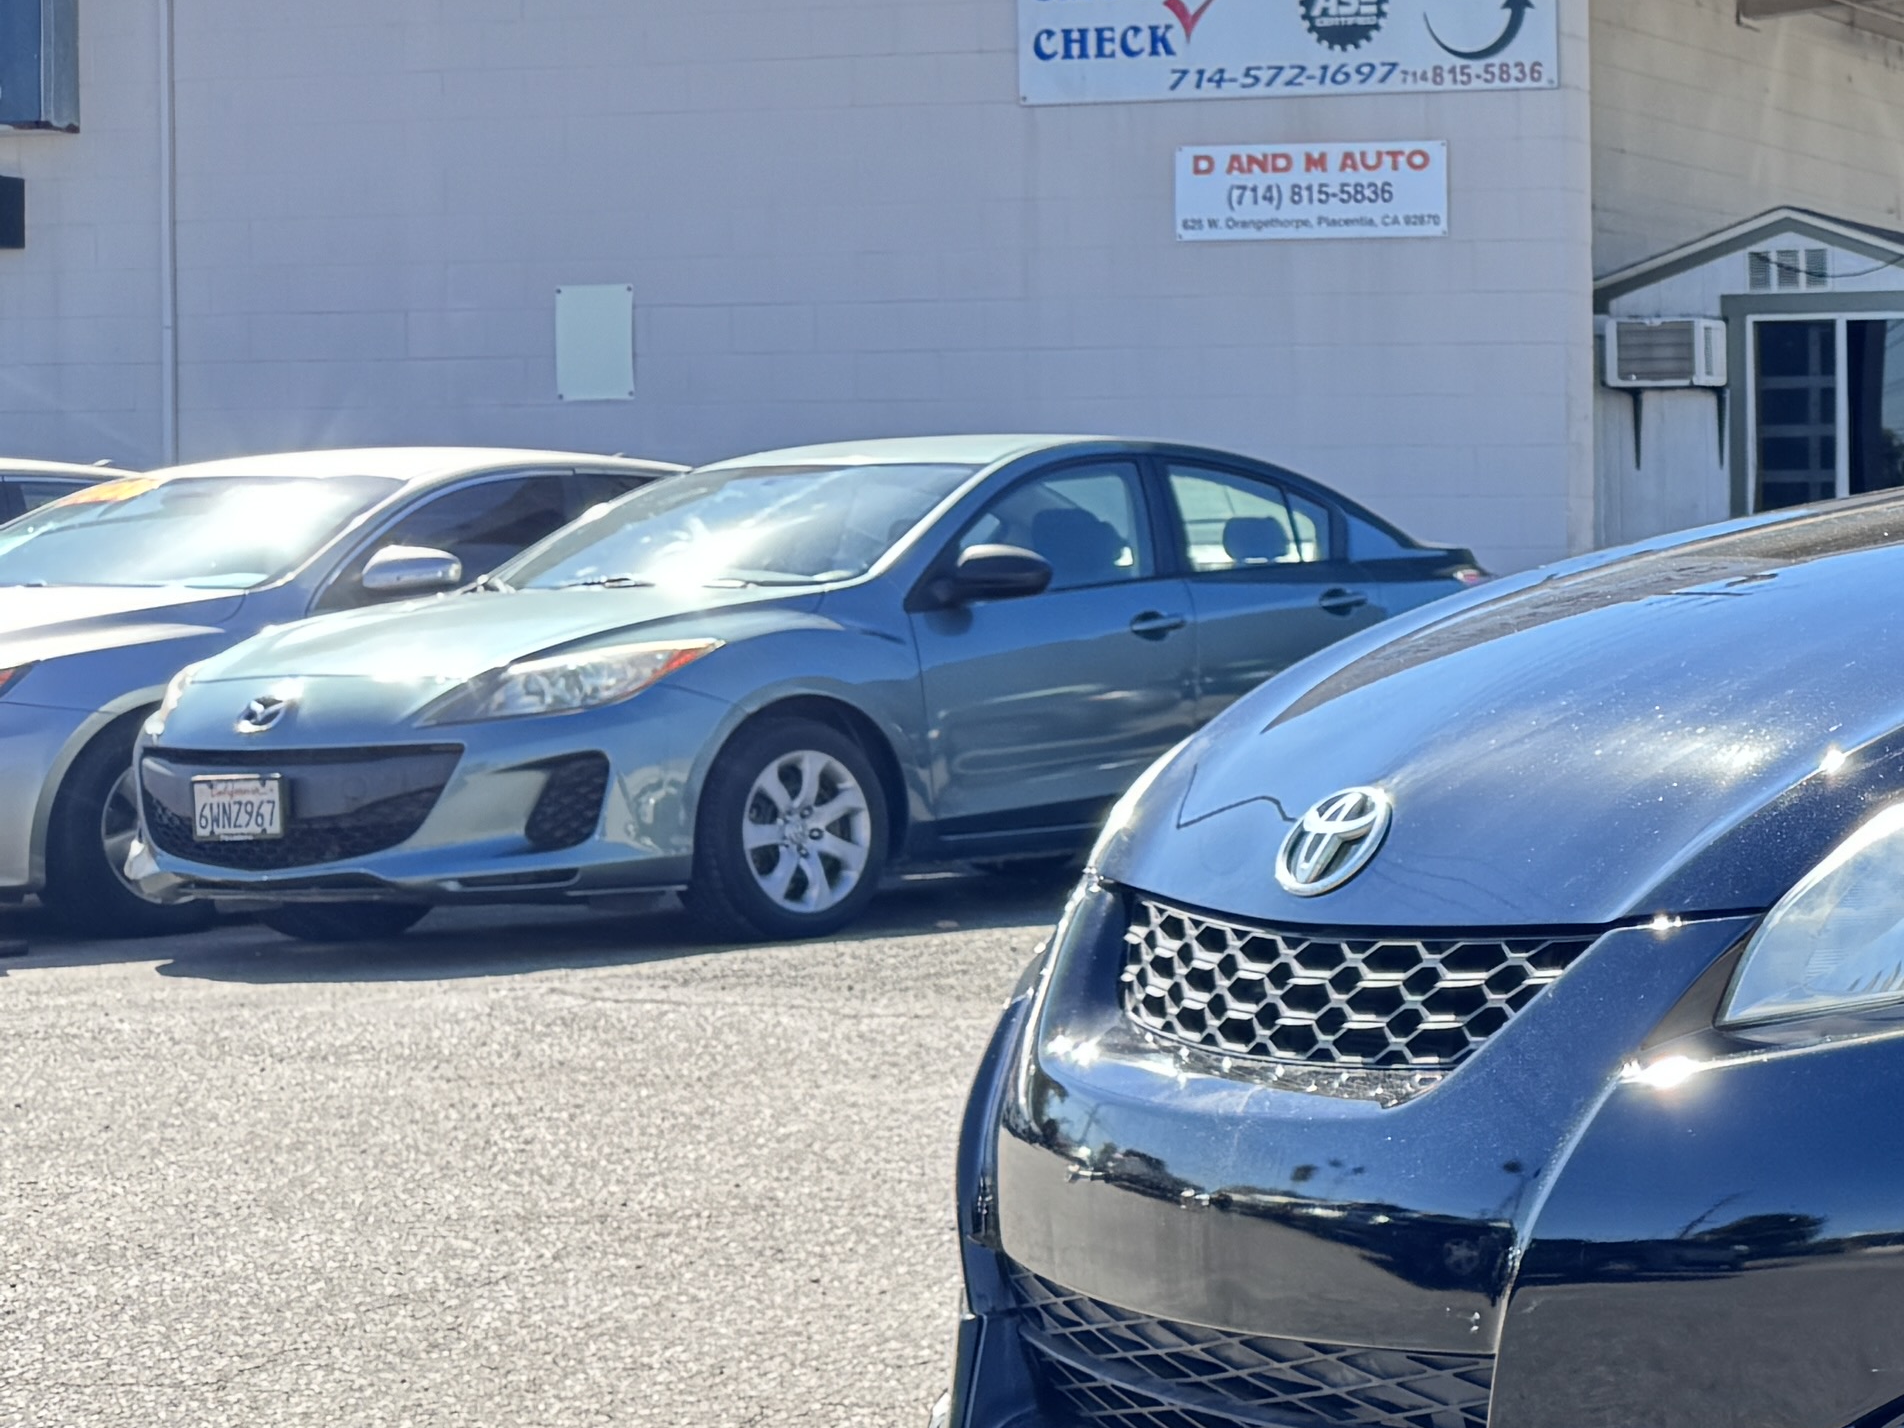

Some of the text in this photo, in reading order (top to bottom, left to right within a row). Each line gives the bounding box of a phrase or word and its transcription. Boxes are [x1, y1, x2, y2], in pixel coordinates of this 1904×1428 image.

[1033, 24, 1177, 62] CHECK
[1168, 62, 1399, 91] 714-572-1697
[1193, 149, 1430, 176] D AND M AUTO
[1227, 181, 1394, 212] (714) 815-5836
[1381, 213, 1400, 227] CA
[199, 800, 276, 829] 6WNZ967
